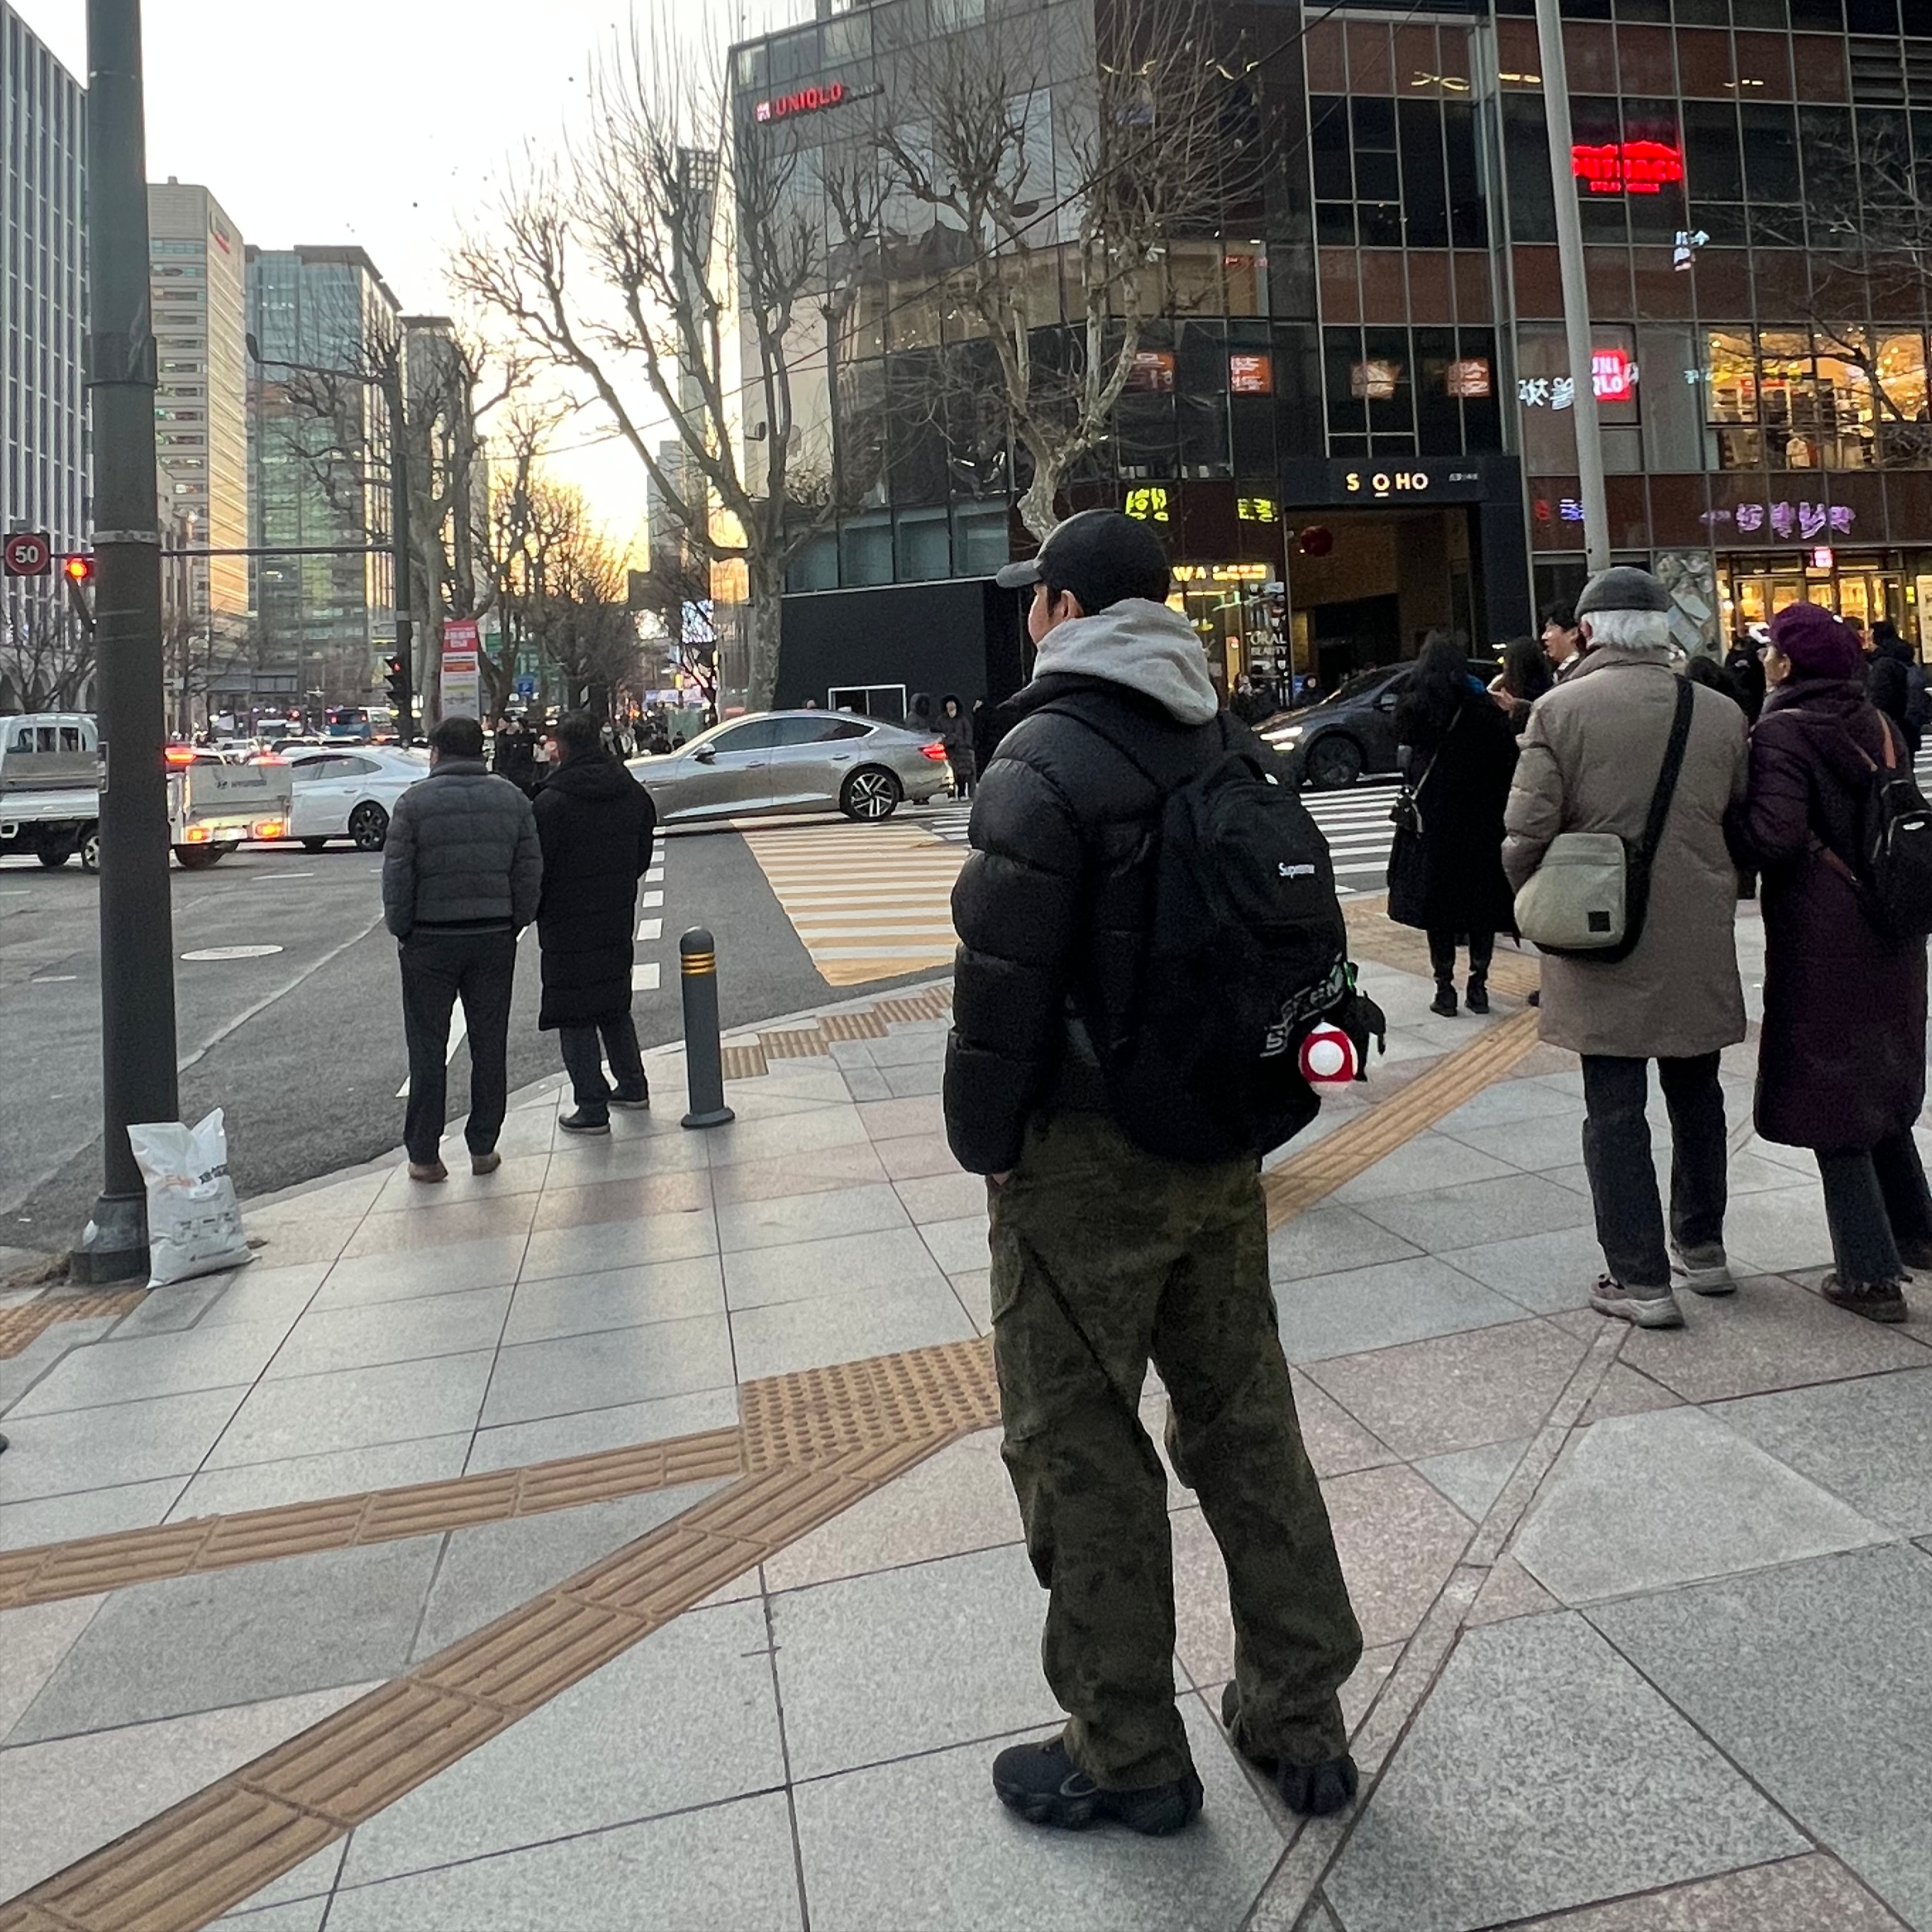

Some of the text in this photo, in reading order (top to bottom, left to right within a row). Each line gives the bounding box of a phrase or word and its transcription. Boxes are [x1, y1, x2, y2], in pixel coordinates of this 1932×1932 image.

[775, 82, 843, 116] UNIQLO
[15, 545, 38, 563] 50
[1250, 631, 1287, 645] ORAL
